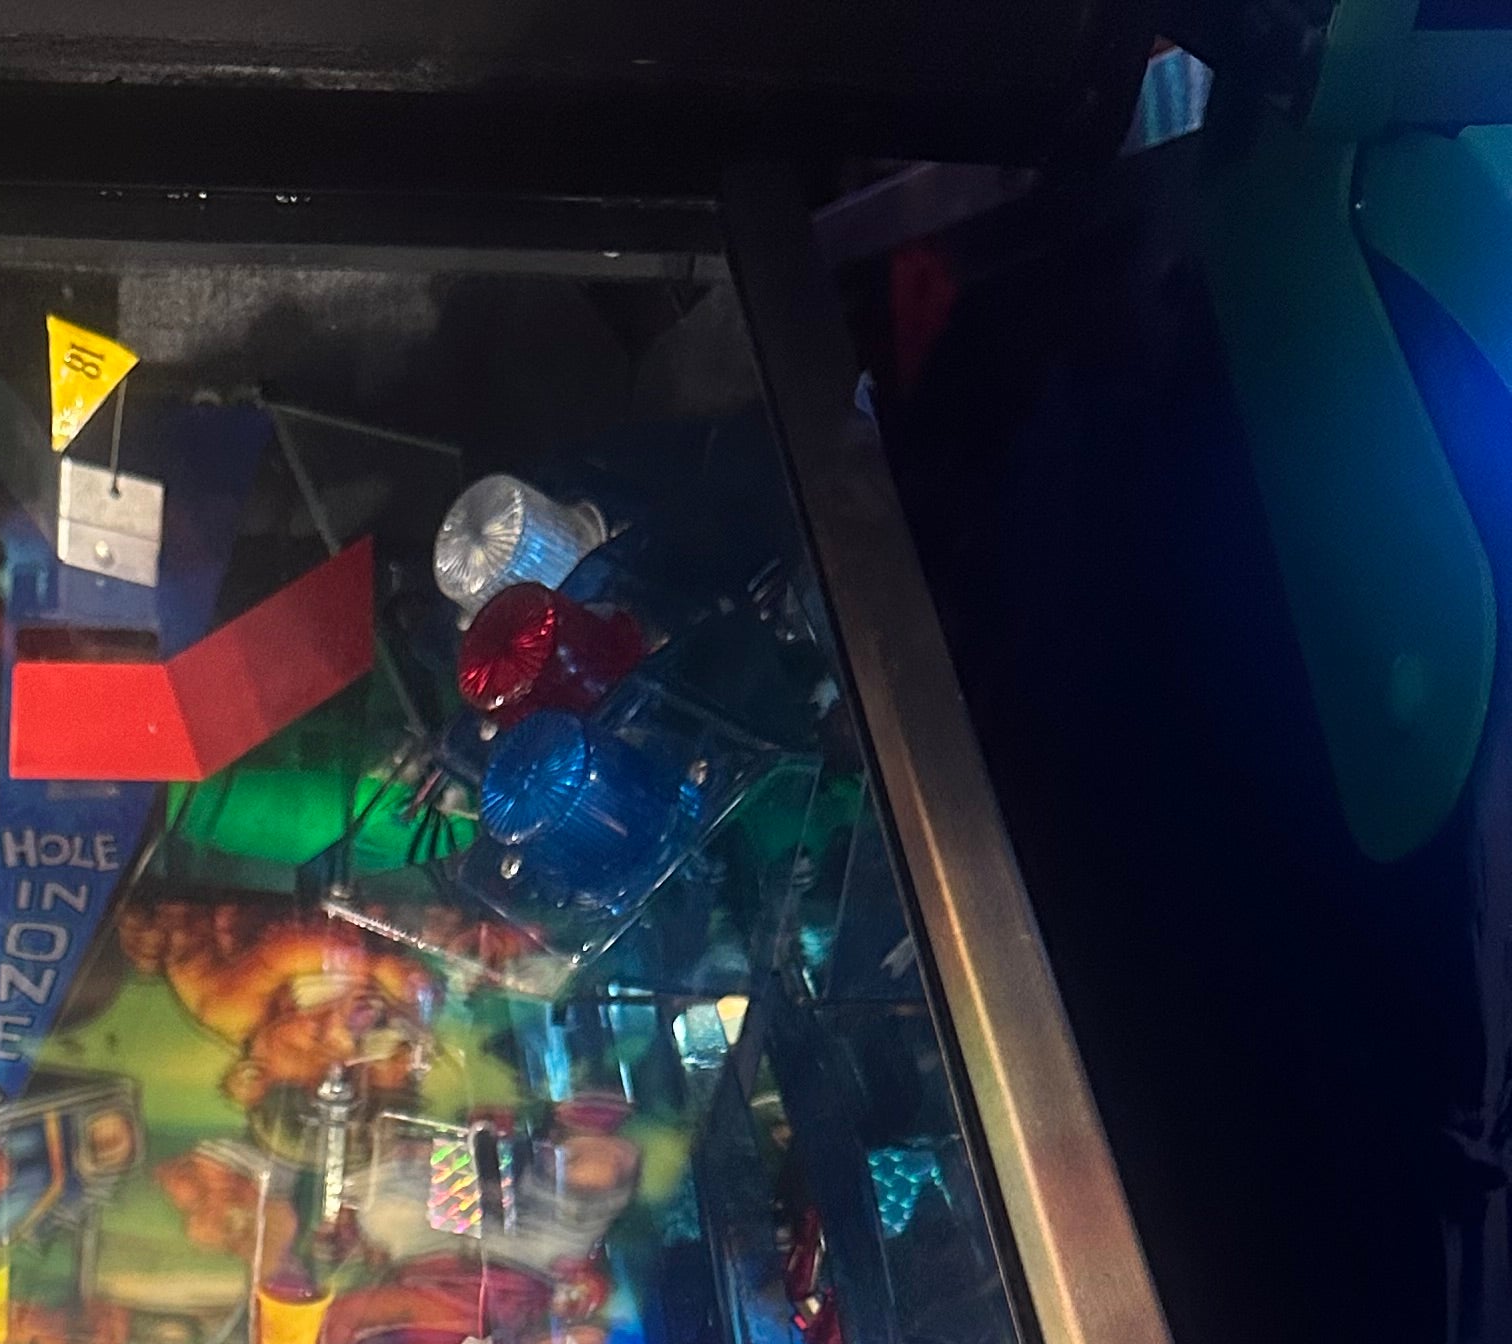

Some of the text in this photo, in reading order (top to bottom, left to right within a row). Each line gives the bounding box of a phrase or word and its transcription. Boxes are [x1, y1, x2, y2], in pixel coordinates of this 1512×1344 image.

[62, 342, 108, 382] 18
[2, 828, 120, 872] HOLE
[16, 878, 88, 914] IN
